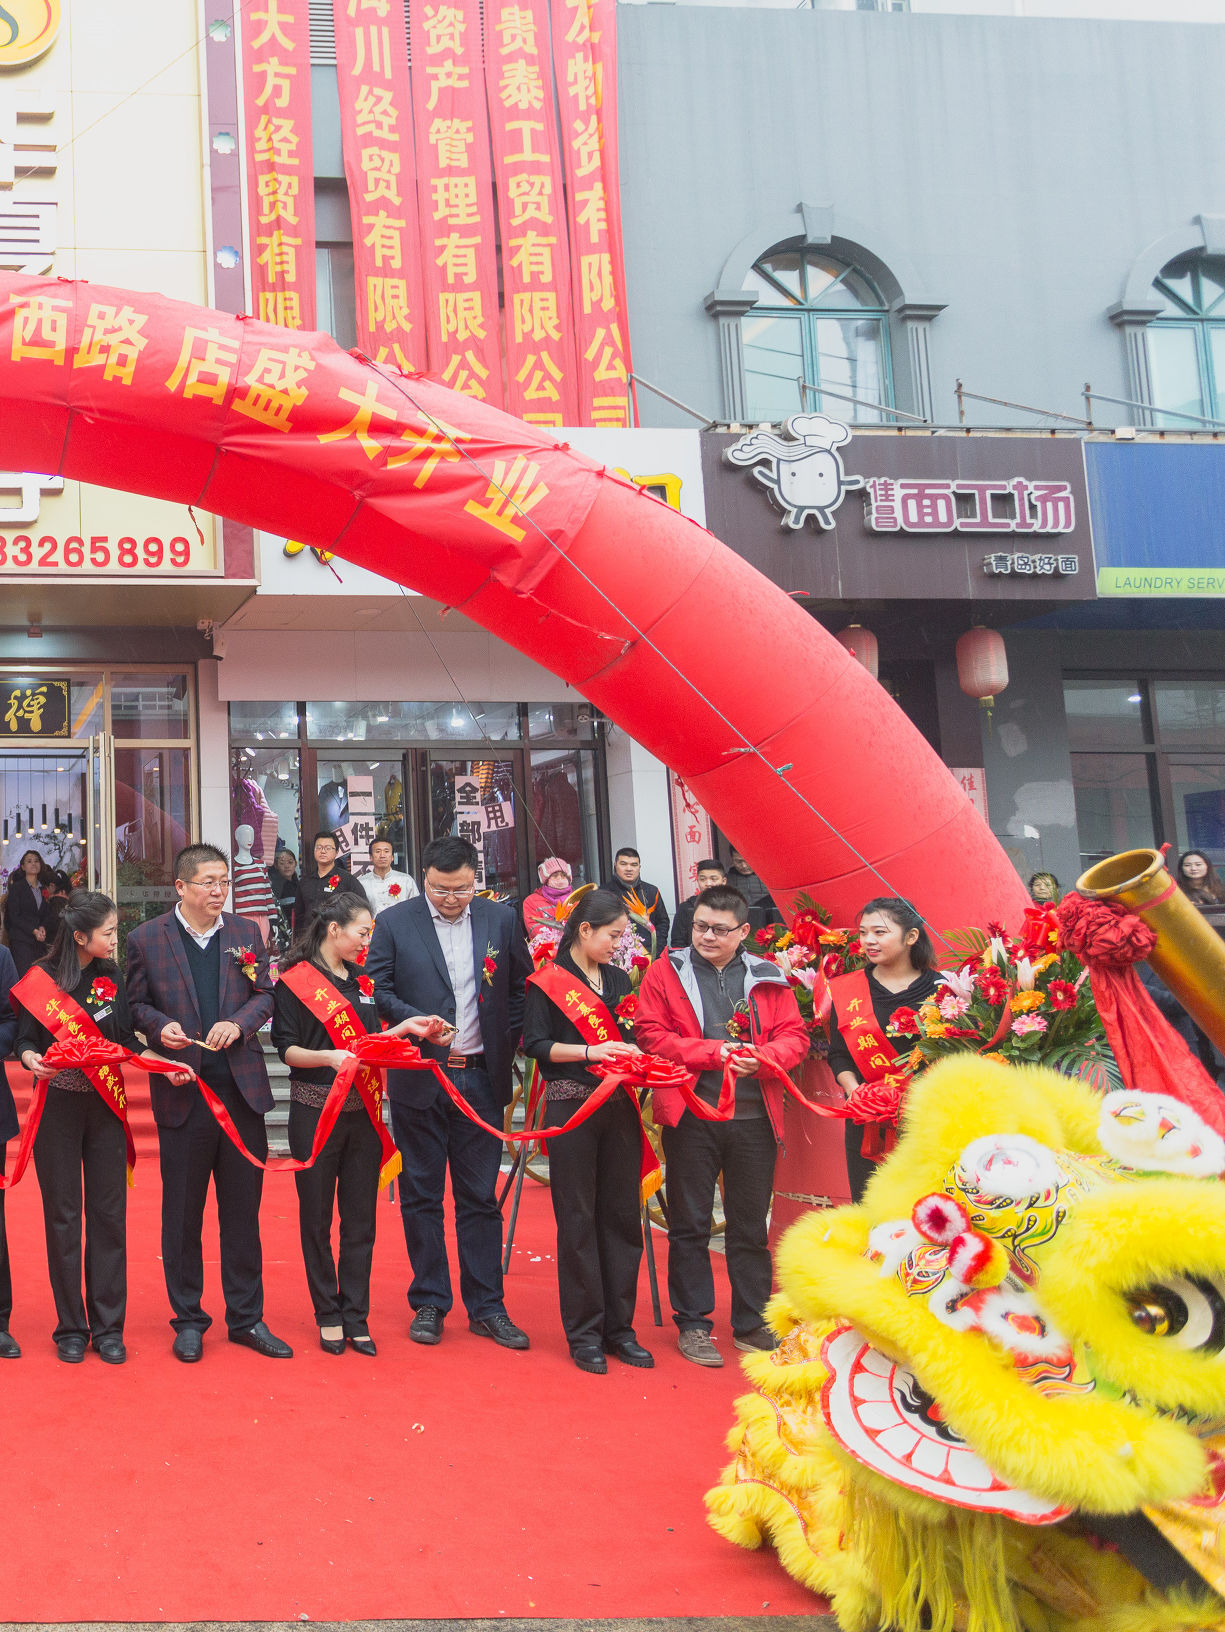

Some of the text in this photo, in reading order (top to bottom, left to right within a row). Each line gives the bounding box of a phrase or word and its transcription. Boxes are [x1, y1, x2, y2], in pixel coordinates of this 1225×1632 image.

[250, 0, 302, 331] 大方经贸有限
[899, 480, 1073, 531] 面工场
[992, 554, 1078, 573] 青岛好面
[1115, 577, 1183, 589] LAUNDRY
[485, 803, 509, 829] 甩
